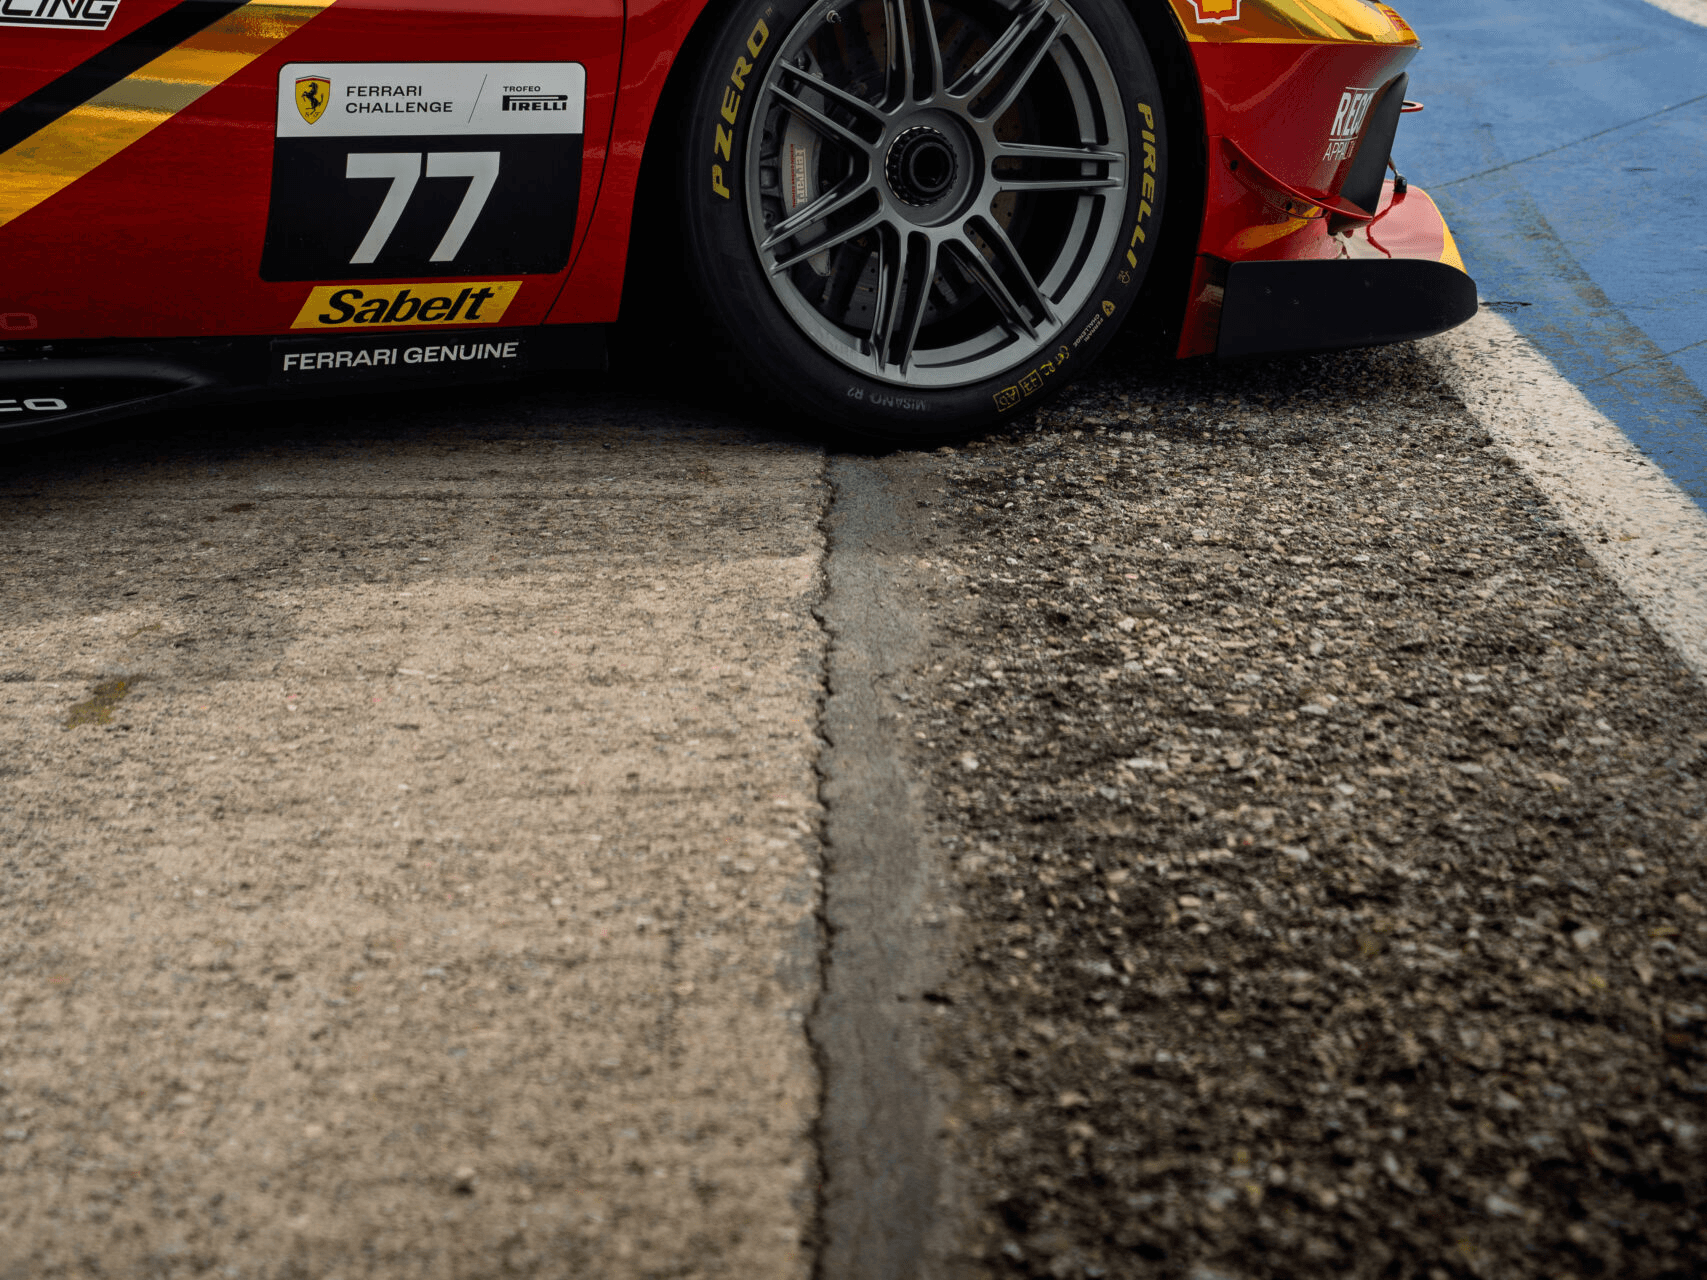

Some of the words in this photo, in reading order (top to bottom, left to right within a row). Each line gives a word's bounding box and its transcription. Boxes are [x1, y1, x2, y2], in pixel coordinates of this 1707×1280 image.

[346, 86, 423, 97] FERRARI
[502, 95, 568, 111] PIRELLI
[345, 102, 453, 114] CHALLENGE
[1127, 102, 1157, 269] PIRELLI
[345, 151, 500, 264] 77
[318, 286, 495, 325] Sabelt
[283, 348, 398, 371] FERRARI
[403, 341, 519, 365] GENUINE
